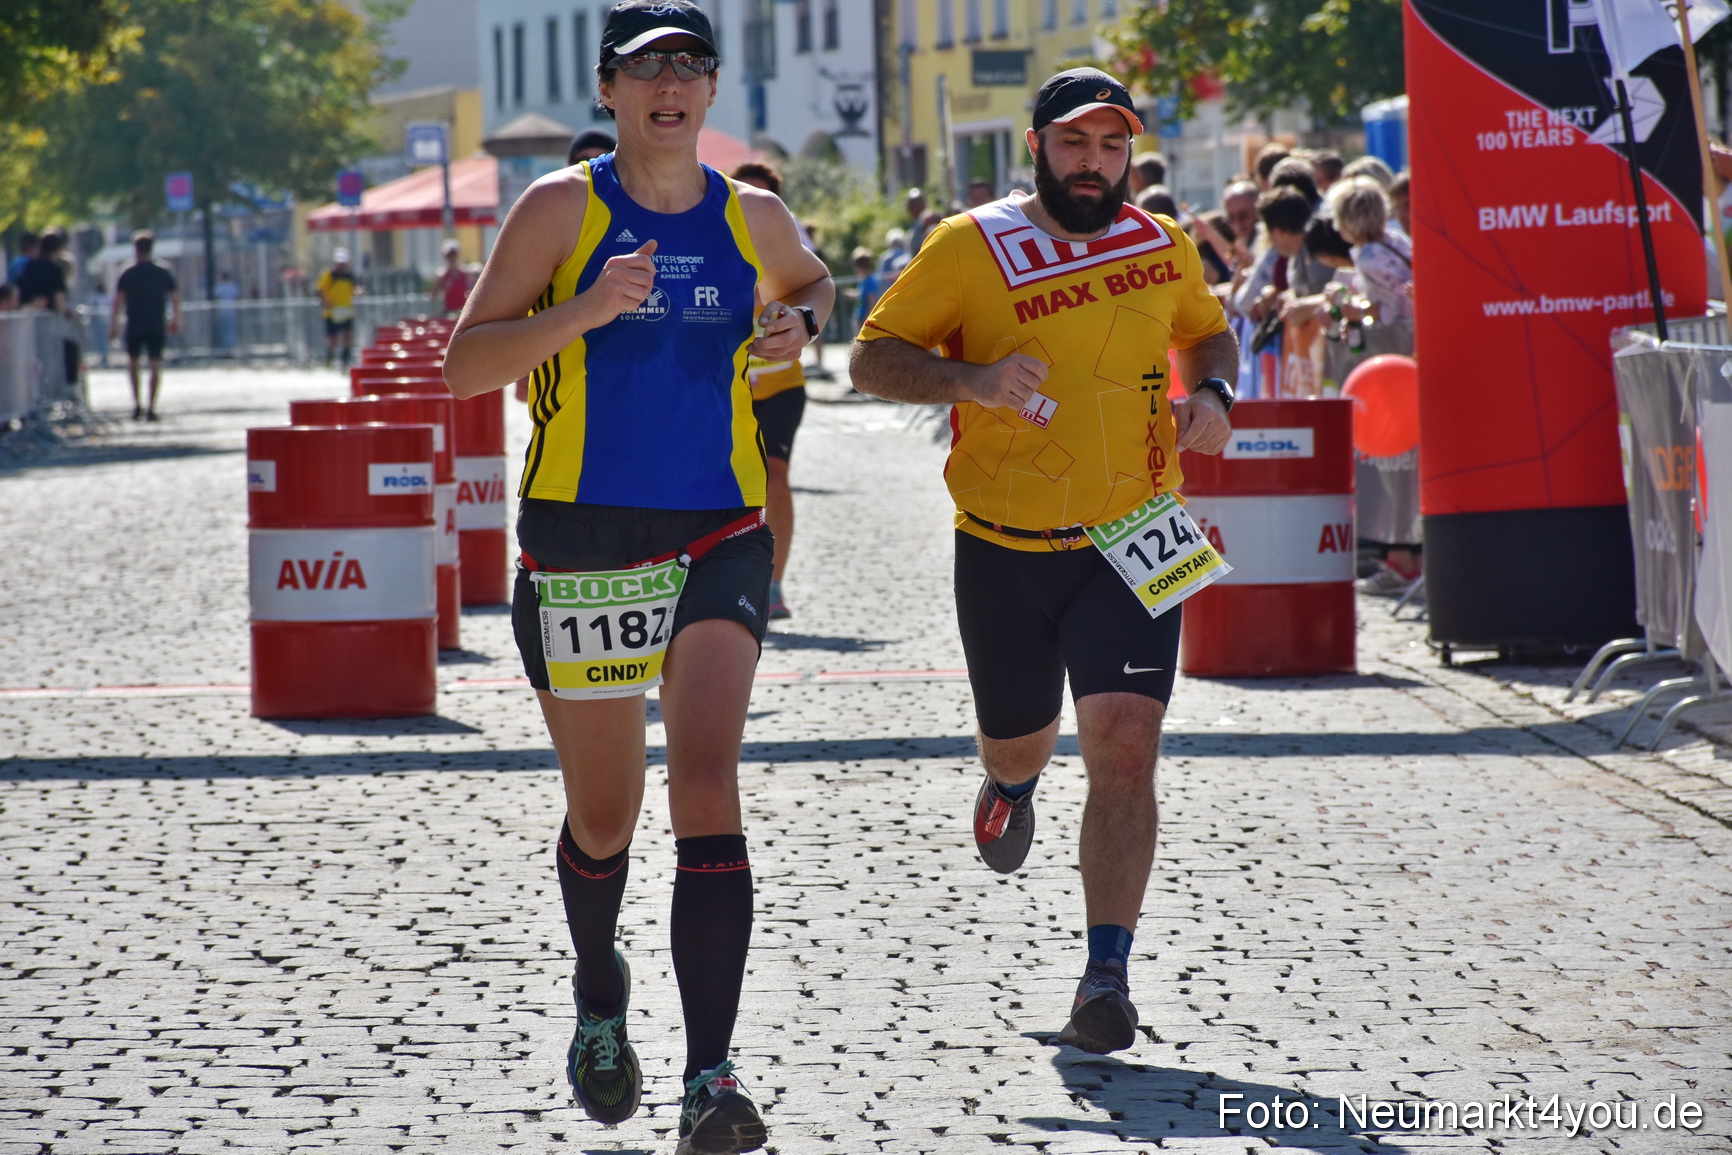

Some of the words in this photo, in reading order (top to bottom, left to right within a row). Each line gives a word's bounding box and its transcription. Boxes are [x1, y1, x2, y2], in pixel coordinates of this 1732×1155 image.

[1505, 110, 1543, 129] THE
[1547, 106, 1598, 127] NEXT
[1477, 133, 1507, 150] 100
[1510, 128, 1575, 148] YEARS
[1479, 204, 1548, 231] BMW
[651, 255, 704, 264] NTERSPORT
[694, 286, 720, 306] FR
[1013, 281, 1100, 325] MAX
[1103, 260, 1182, 297] BÖGL
[734, 522, 758, 537] balance
[548, 565, 677, 604] BOCK
[559, 606, 668, 654] 1182
[586, 662, 649, 683] CINDY
